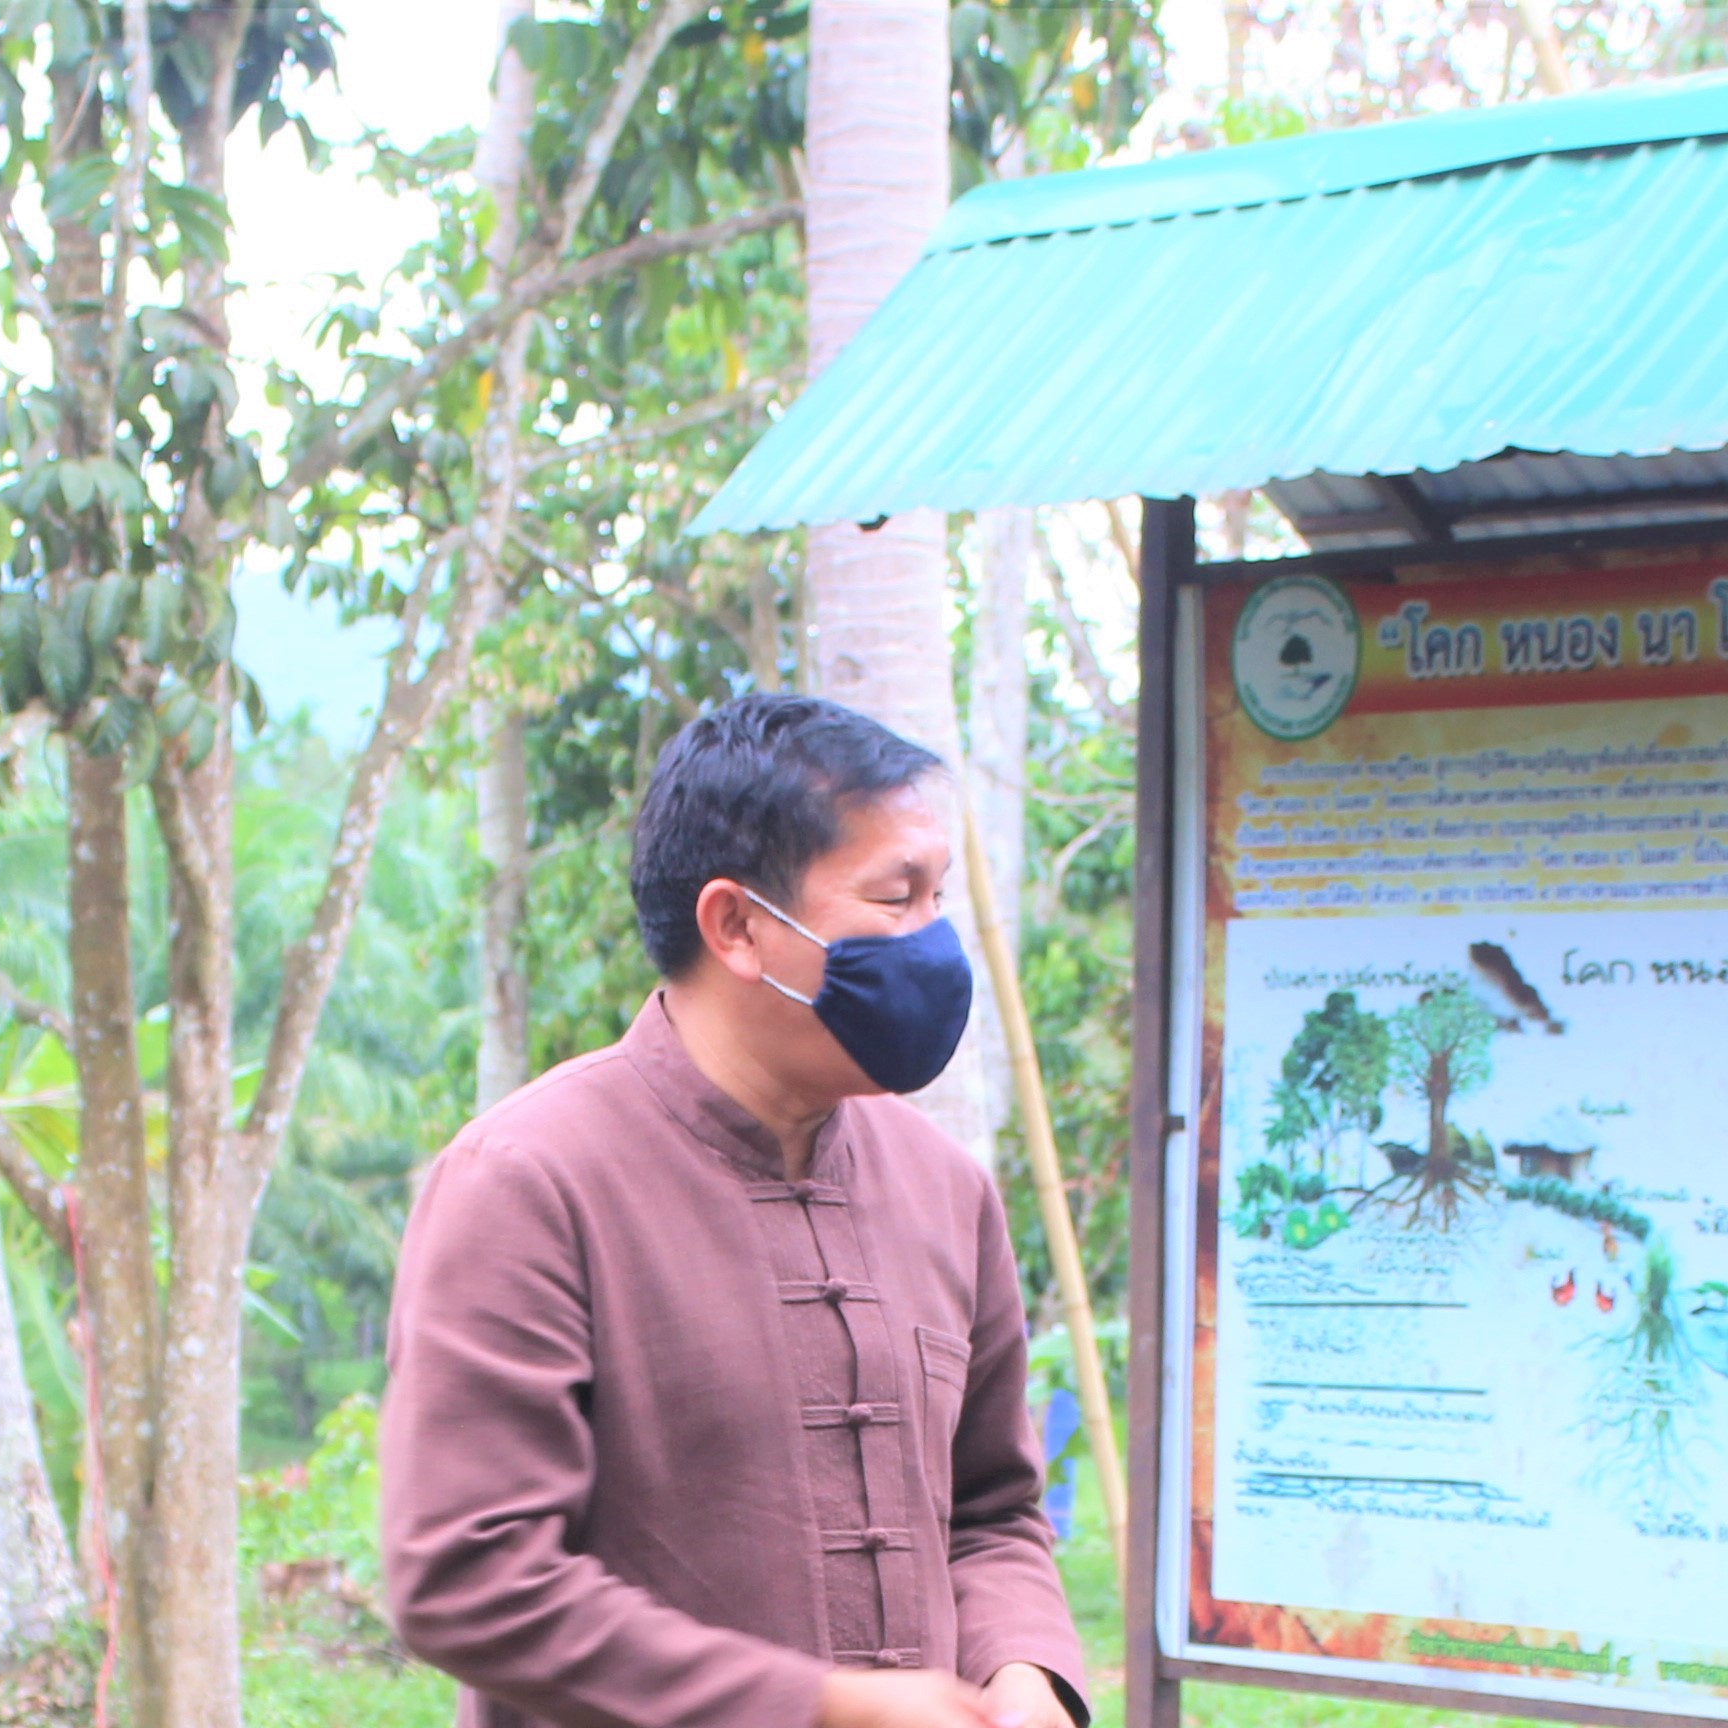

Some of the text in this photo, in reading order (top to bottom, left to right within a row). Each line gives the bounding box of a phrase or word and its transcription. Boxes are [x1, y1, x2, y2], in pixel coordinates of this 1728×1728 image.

[1500, 614, 1621, 671] หนอง
[1639, 607, 1699, 664] นา
[1561, 945, 1635, 987] โคก
